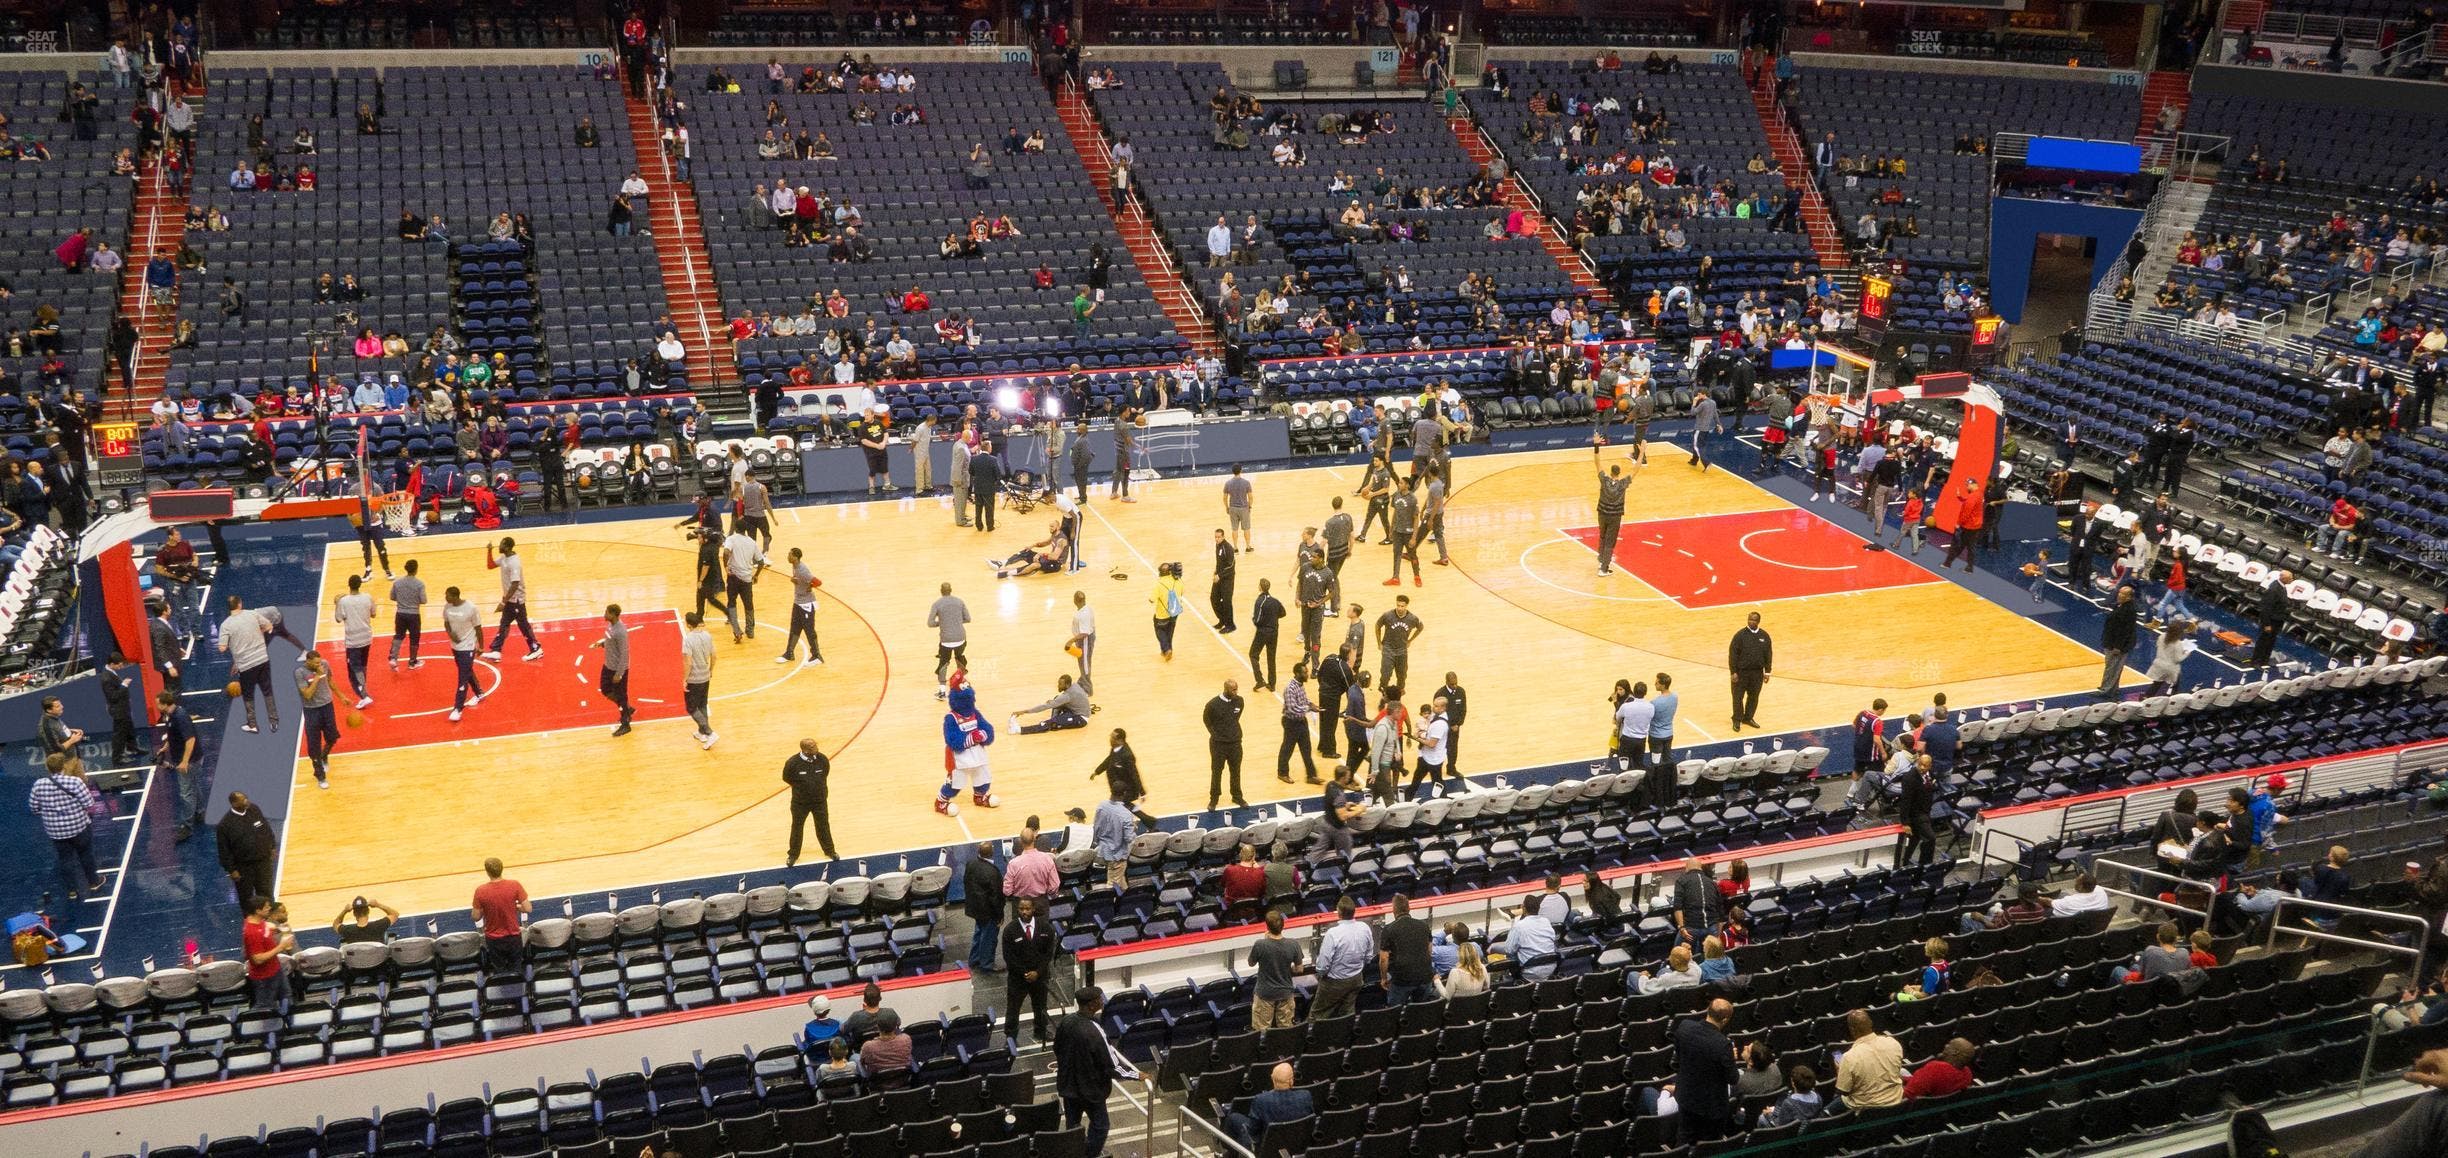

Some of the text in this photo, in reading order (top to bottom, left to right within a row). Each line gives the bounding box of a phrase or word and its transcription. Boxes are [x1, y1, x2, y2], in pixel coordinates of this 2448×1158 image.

[1005, 52, 1027, 62] 100
[1377, 51, 1393, 62] 121
[1715, 54, 1734, 64] 120
[2116, 75, 2135, 85] 119
[1870, 282, 1888, 298] 8:07
[106, 428, 134, 441] 8:07
